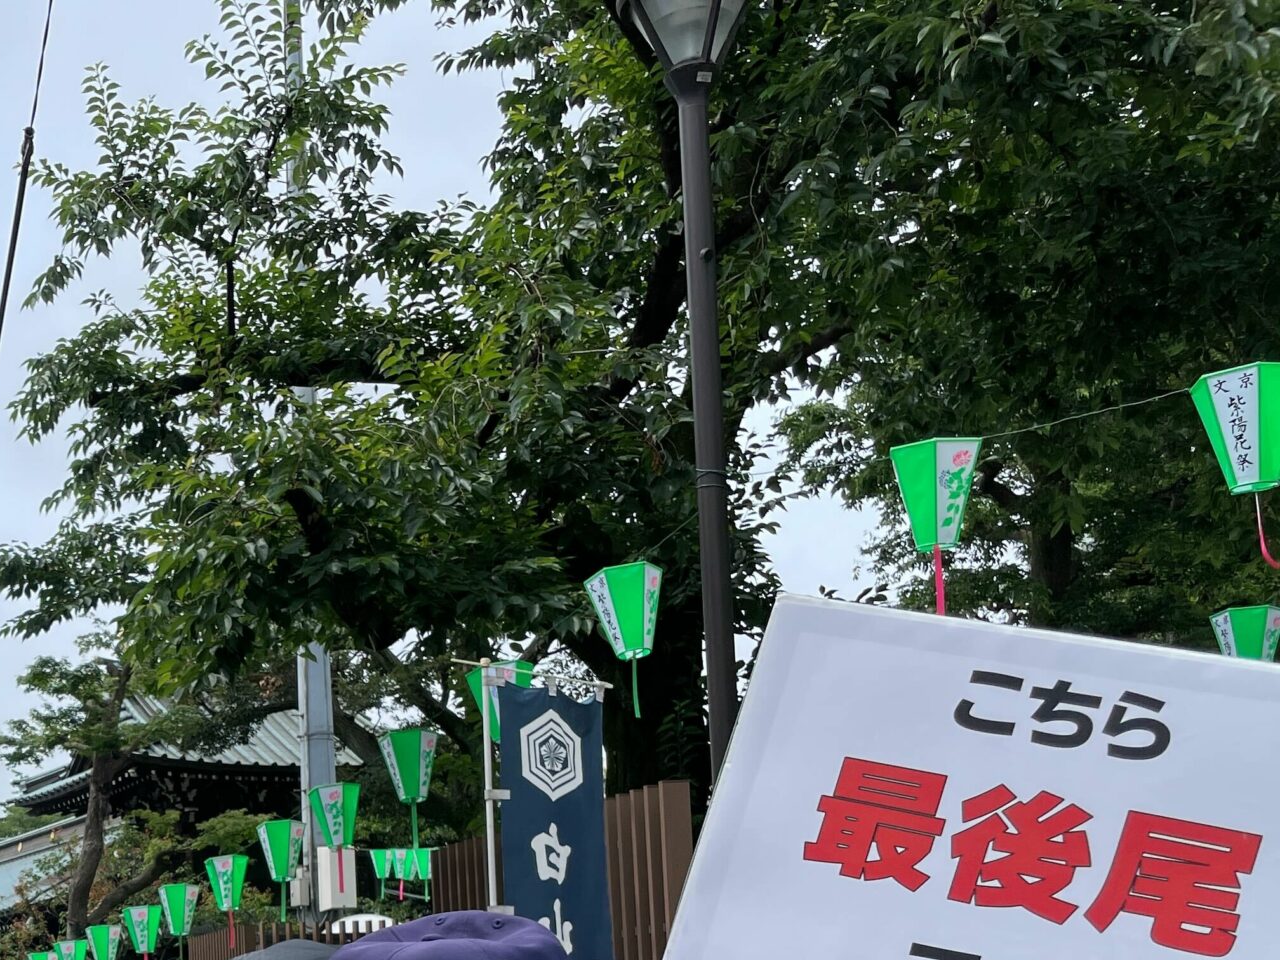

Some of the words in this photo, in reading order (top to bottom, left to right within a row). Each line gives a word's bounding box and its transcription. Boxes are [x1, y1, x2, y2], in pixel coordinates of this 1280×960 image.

[953, 670, 1171, 760] こちら
[803, 756, 1263, 957] 最後尾
